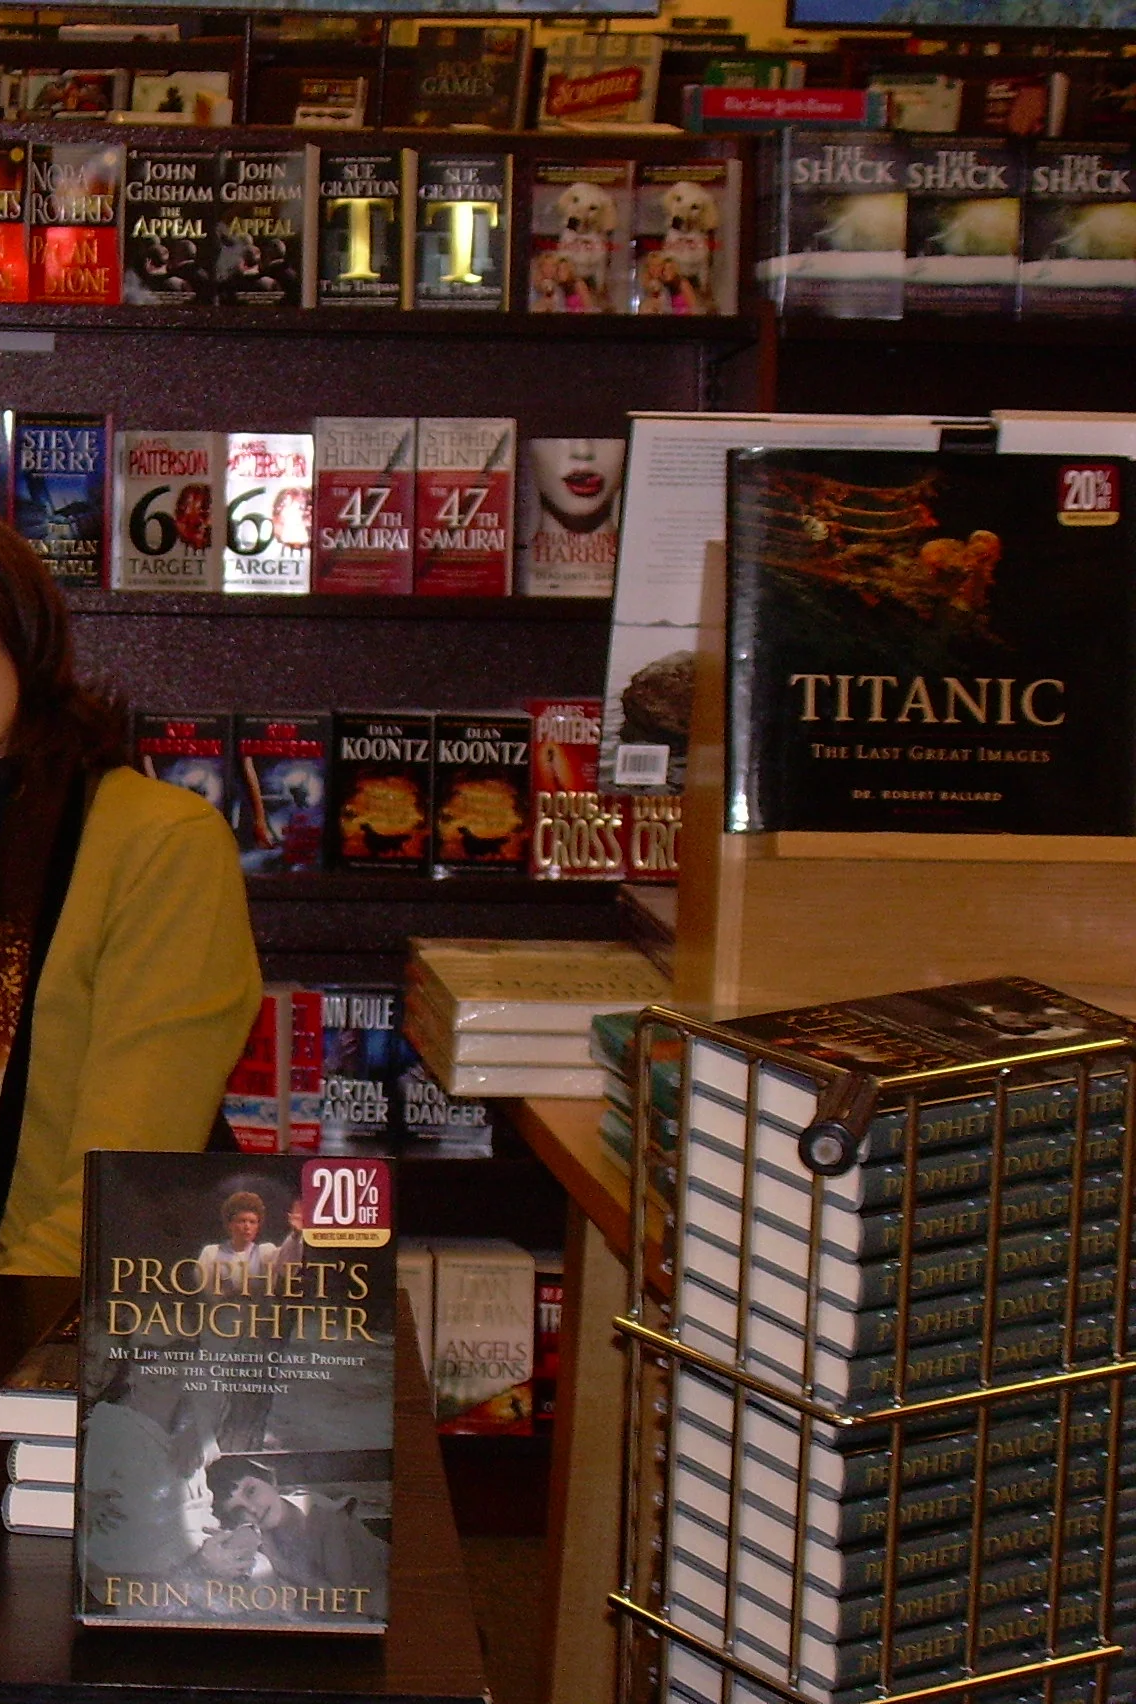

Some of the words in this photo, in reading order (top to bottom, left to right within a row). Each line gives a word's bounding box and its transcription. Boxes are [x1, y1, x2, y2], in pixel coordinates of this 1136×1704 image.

[29, 160, 88, 192] NORA
[144, 160, 196, 183] JOHN
[237, 160, 286, 184] JOHN
[343, 163, 377, 181] SUE
[792, 157, 897, 186] SHACK
[907, 162, 1010, 190] SHACK
[1032, 165, 1132, 194] SHACK
[126, 181, 214, 202] GRISHAM
[220, 181, 303, 202] GRISHAM
[320, 180, 400, 197] GRAFTON
[419, 183, 505, 200] GRAFTON
[30, 192, 115, 224] ROBERTS
[130, 214, 208, 239] APPEAL
[226, 216, 296, 237] APPEAL
[325, 197, 396, 281] T
[423, 200, 500, 284] T
[23, 430, 98, 451] STEVE
[326, 430, 406, 447] STEPHEN
[426, 430, 506, 447] STEPHEN
[21, 451, 99, 473] BERRY
[129, 449, 209, 477] PATTERSON
[338, 487, 392, 527] 47
[436, 487, 489, 528] 47
[322, 527, 410, 553] SAMURAI
[419, 527, 506, 554] SAMURAI
[128, 558, 206, 576] TARGET
[790, 673, 1066, 727] TITANIC
[340, 736, 430, 762] KOONTZ
[437, 739, 529, 766] KOONTZ
[811, 743, 849, 760] THE
[855, 744, 902, 761] LAST
[907, 746, 972, 762] GREAT
[978, 747, 1051, 764] IMAGES
[881, 790, 934, 801] ROBERT
[939, 791, 1002, 802] BALLARD
[533, 817, 624, 870] CROSS
[351, 995, 395, 1031] RULE
[406, 1102, 487, 1125] DANGER
[358, 1206, 380, 1225] OFF
[110, 1256, 371, 1301] PROPHET'S
[106, 1299, 378, 1343] DAUGHTER
[444, 1340, 528, 1362] ANGELS
[445, 1360, 526, 1380] DEMONS
[104, 1576, 190, 1607] ERIN
[206, 1579, 371, 1614] PROPHET
